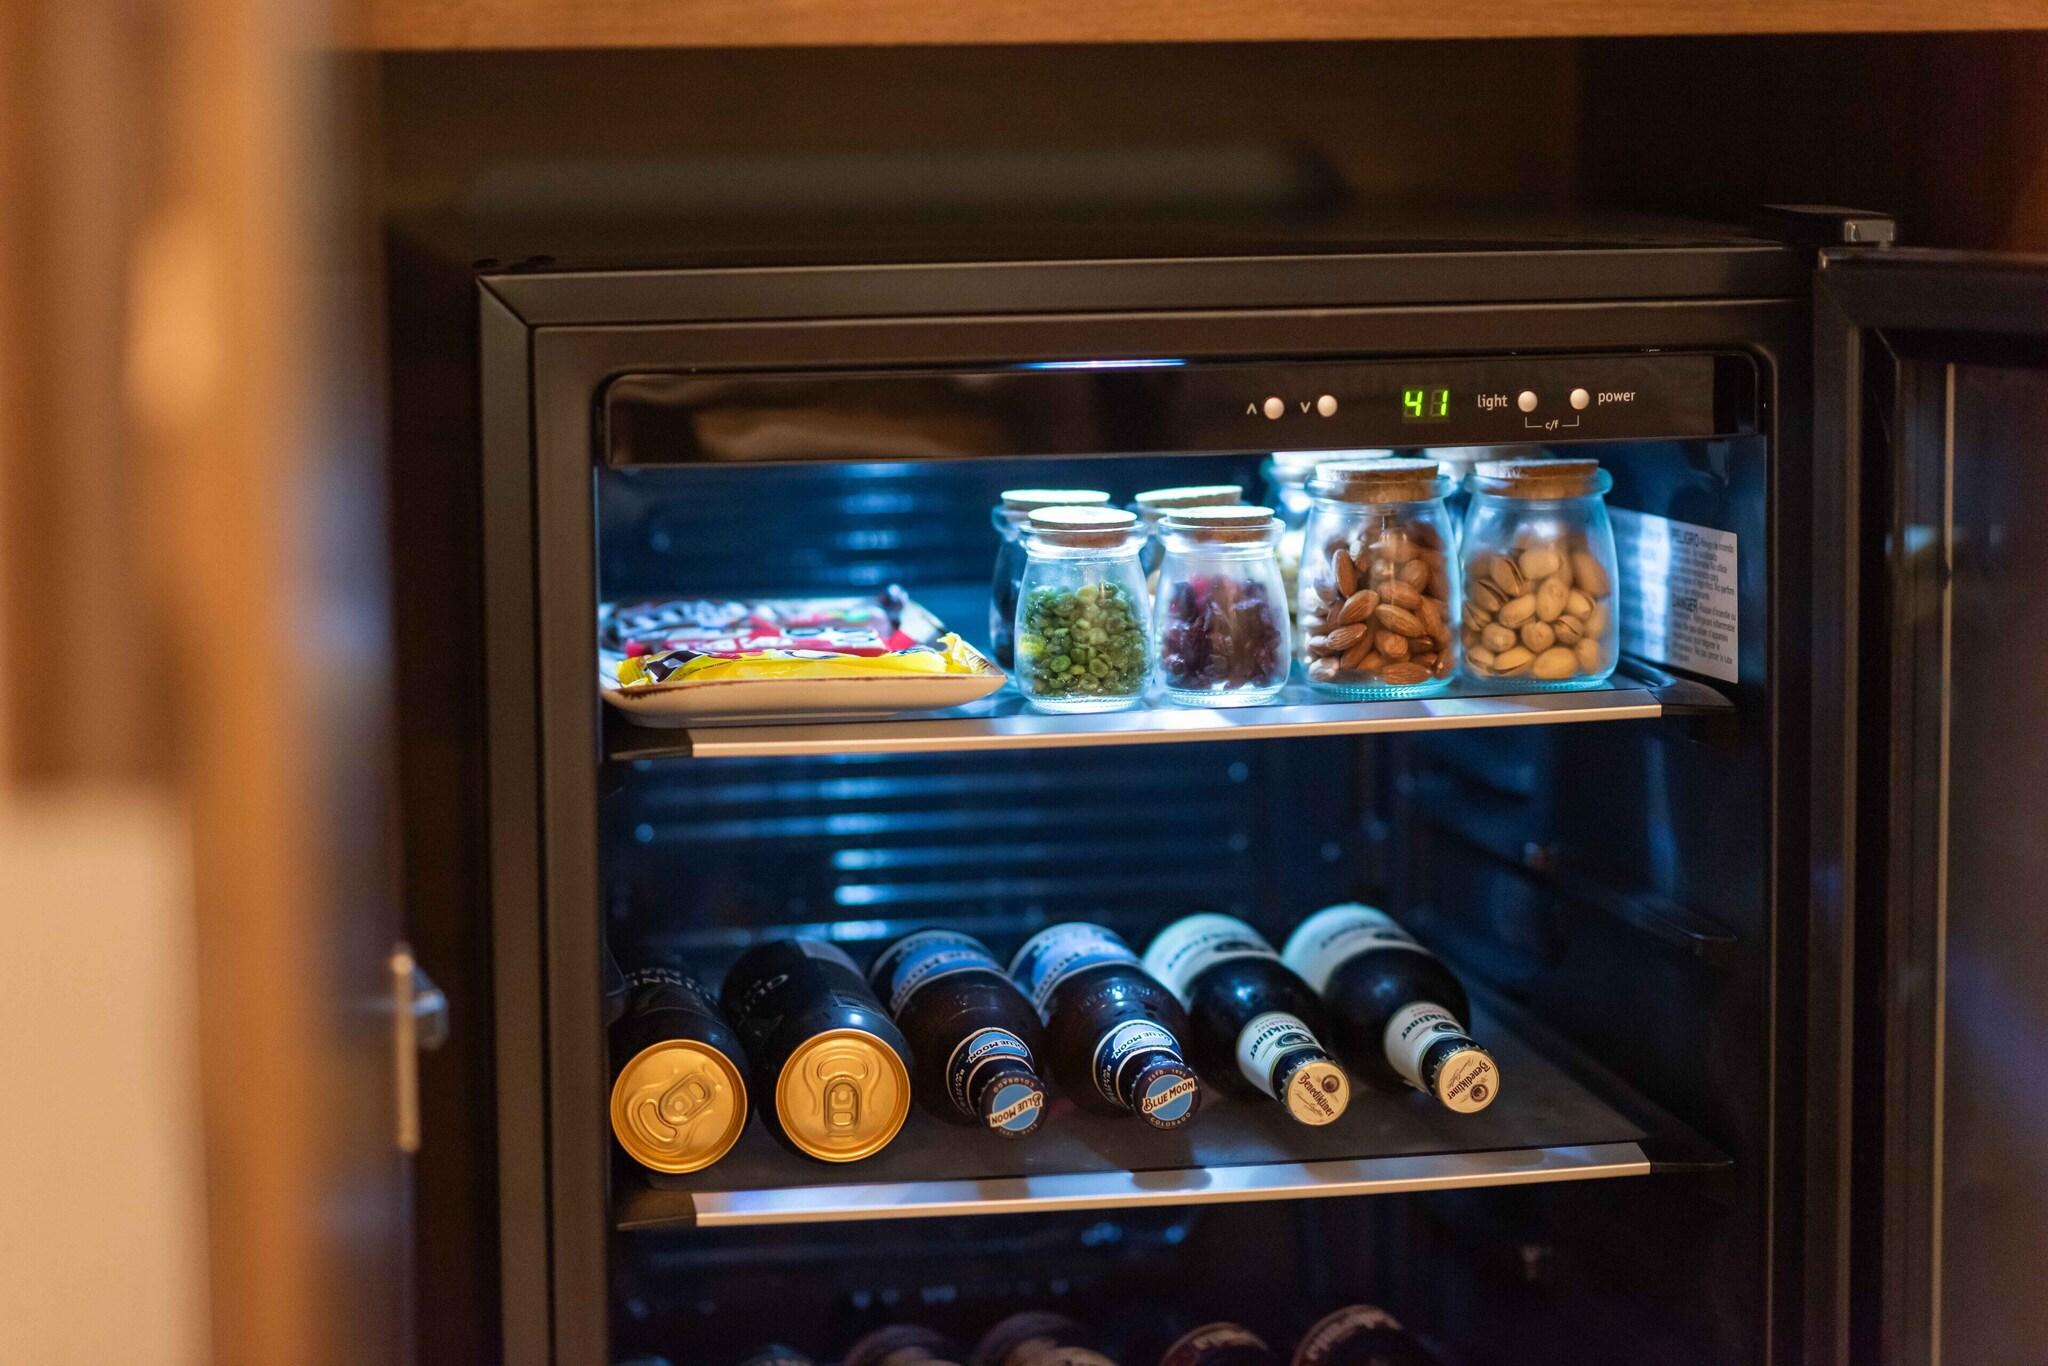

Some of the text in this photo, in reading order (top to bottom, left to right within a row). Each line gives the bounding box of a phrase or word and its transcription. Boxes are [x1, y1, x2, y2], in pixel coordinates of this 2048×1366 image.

[1404, 390, 1449, 417] 41
[1477, 394, 1508, 411] light
[1598, 390, 1636, 406] power
[1545, 419, 1560, 431] c/f
[968, 1042, 999, 1062] MOON
[1114, 1034, 1142, 1058] MOON
[993, 1076, 1035, 1093] COLORADO
[1447, 1060, 1491, 1101] Benediktiner
[1143, 1080, 1194, 1113] BLUE MOON
[1297, 1071, 1335, 1117] Benediktiner
[990, 1093, 1043, 1125] BLUE MOON
[1150, 1112, 1192, 1128] COLORADO
